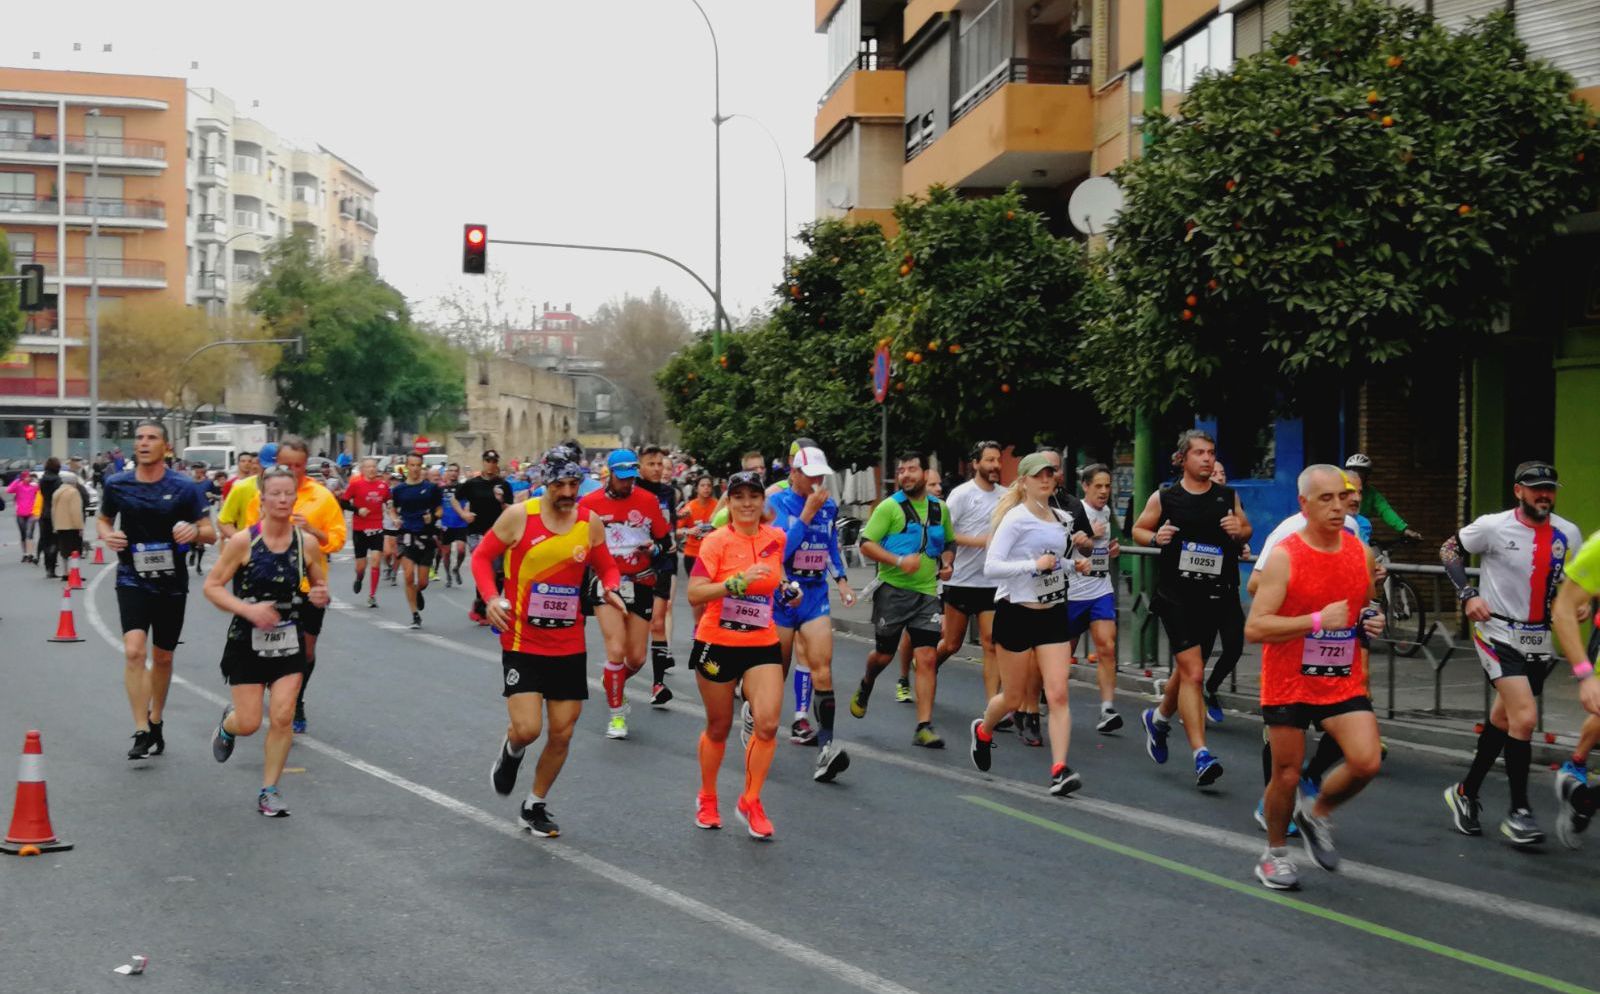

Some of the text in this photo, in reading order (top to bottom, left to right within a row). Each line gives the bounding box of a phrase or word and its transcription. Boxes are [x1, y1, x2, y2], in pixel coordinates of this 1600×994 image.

[1190, 556, 1216, 568] 10253
[543, 600, 568, 611] 6382
[735, 605, 761, 618] 7692
[1319, 645, 1345, 657] 7721
